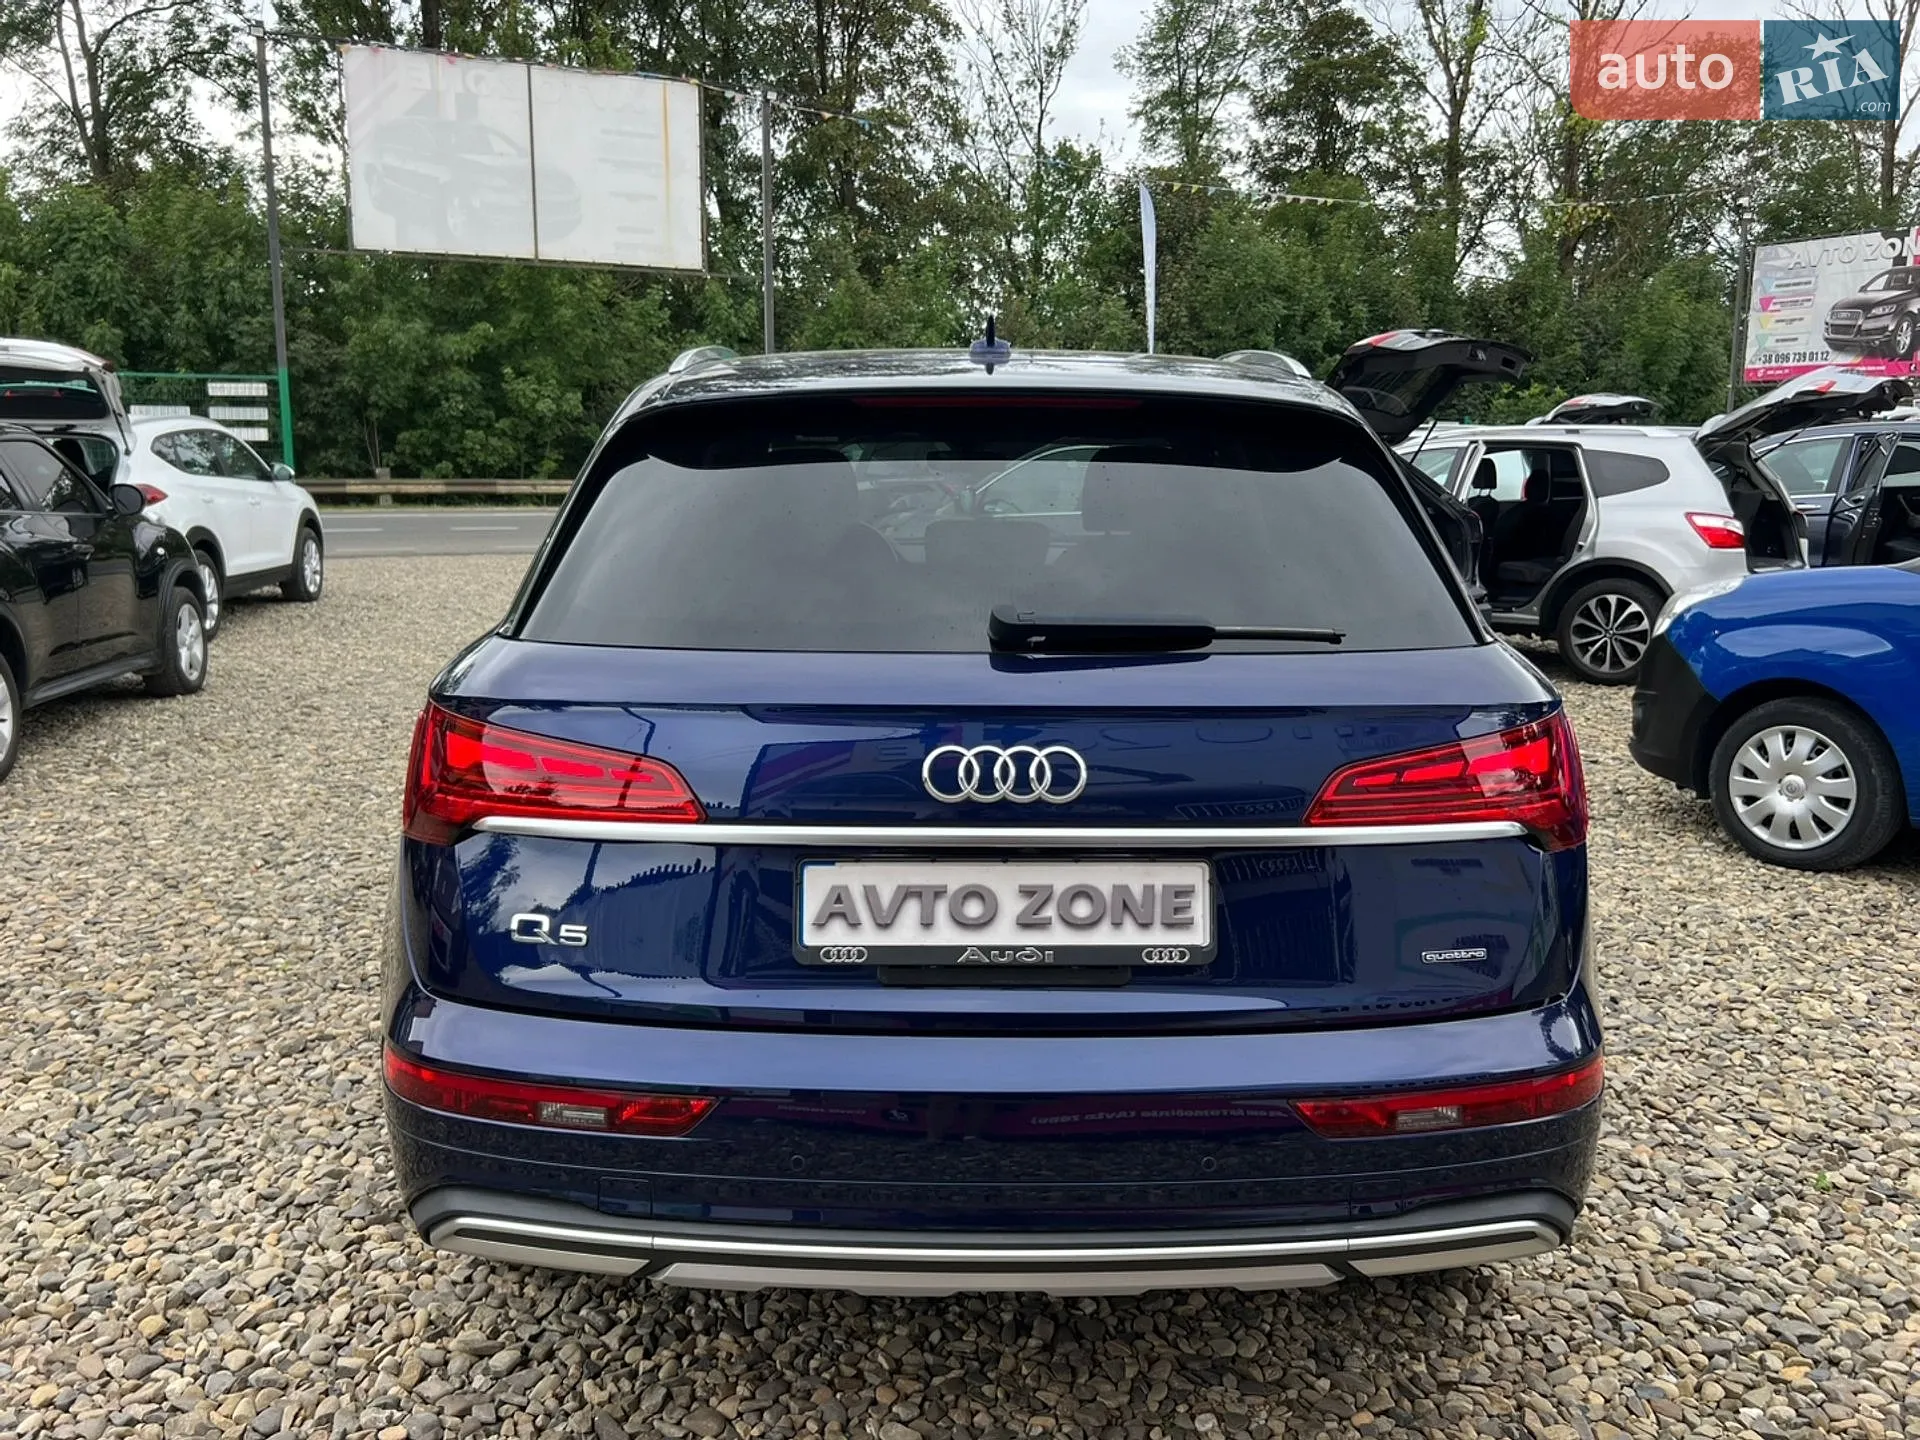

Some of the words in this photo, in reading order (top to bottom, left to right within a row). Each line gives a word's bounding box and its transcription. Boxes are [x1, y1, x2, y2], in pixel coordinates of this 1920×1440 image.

[1787, 240, 1858, 270] AVTO
[1758, 353, 1773, 364] +38
[1774, 352, 1791, 363] 096
[1792, 351, 1807, 362] 739
[812, 884, 998, 927] AVTO
[1016, 884, 1196, 927] ZONE
[510, 913, 588, 946] Q5
[957, 946, 1054, 963] Audi
[1425, 950, 1485, 962] quattro
